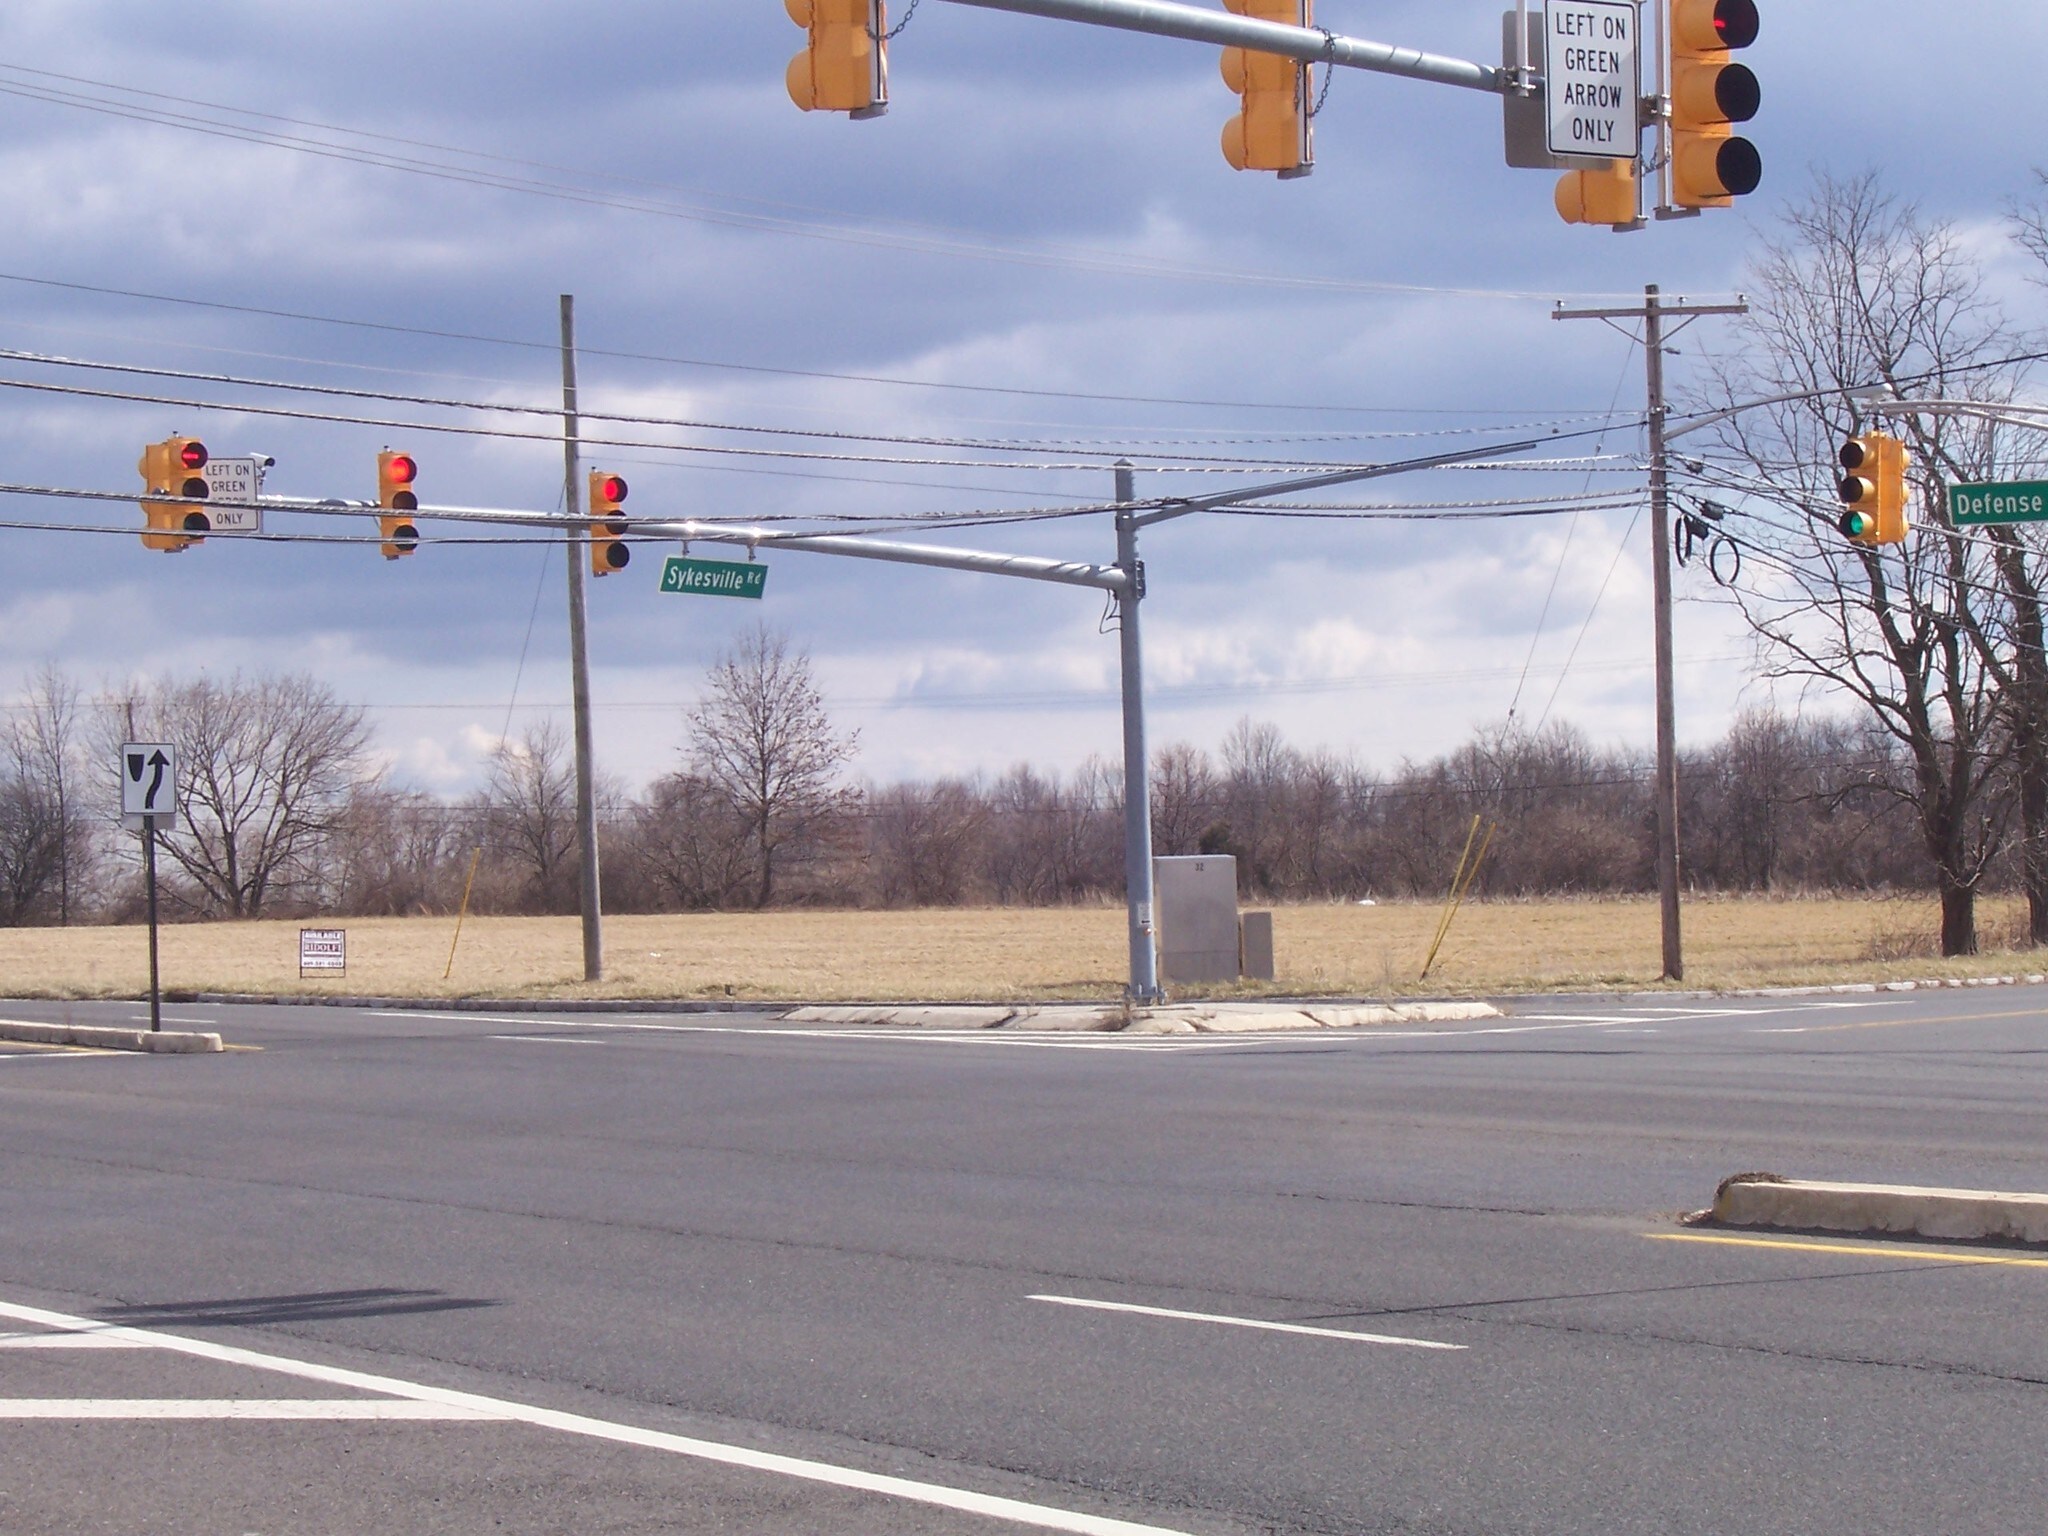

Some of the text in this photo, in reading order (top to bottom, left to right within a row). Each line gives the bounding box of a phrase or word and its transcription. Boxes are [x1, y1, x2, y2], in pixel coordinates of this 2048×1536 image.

[1556, 12, 1626, 40] LEFT ON
[1565, 47, 1619, 74] GREEN
[1564, 82, 1622, 108] ARROW
[1572, 117, 1615, 142] ONLY
[205, 464, 249, 476] LEFT ON
[211, 480, 246, 492] GREEN
[1956, 492, 2042, 515] Defense
[216, 513, 243, 525] ONLY
[668, 565, 761, 590] Sykesville Rd
